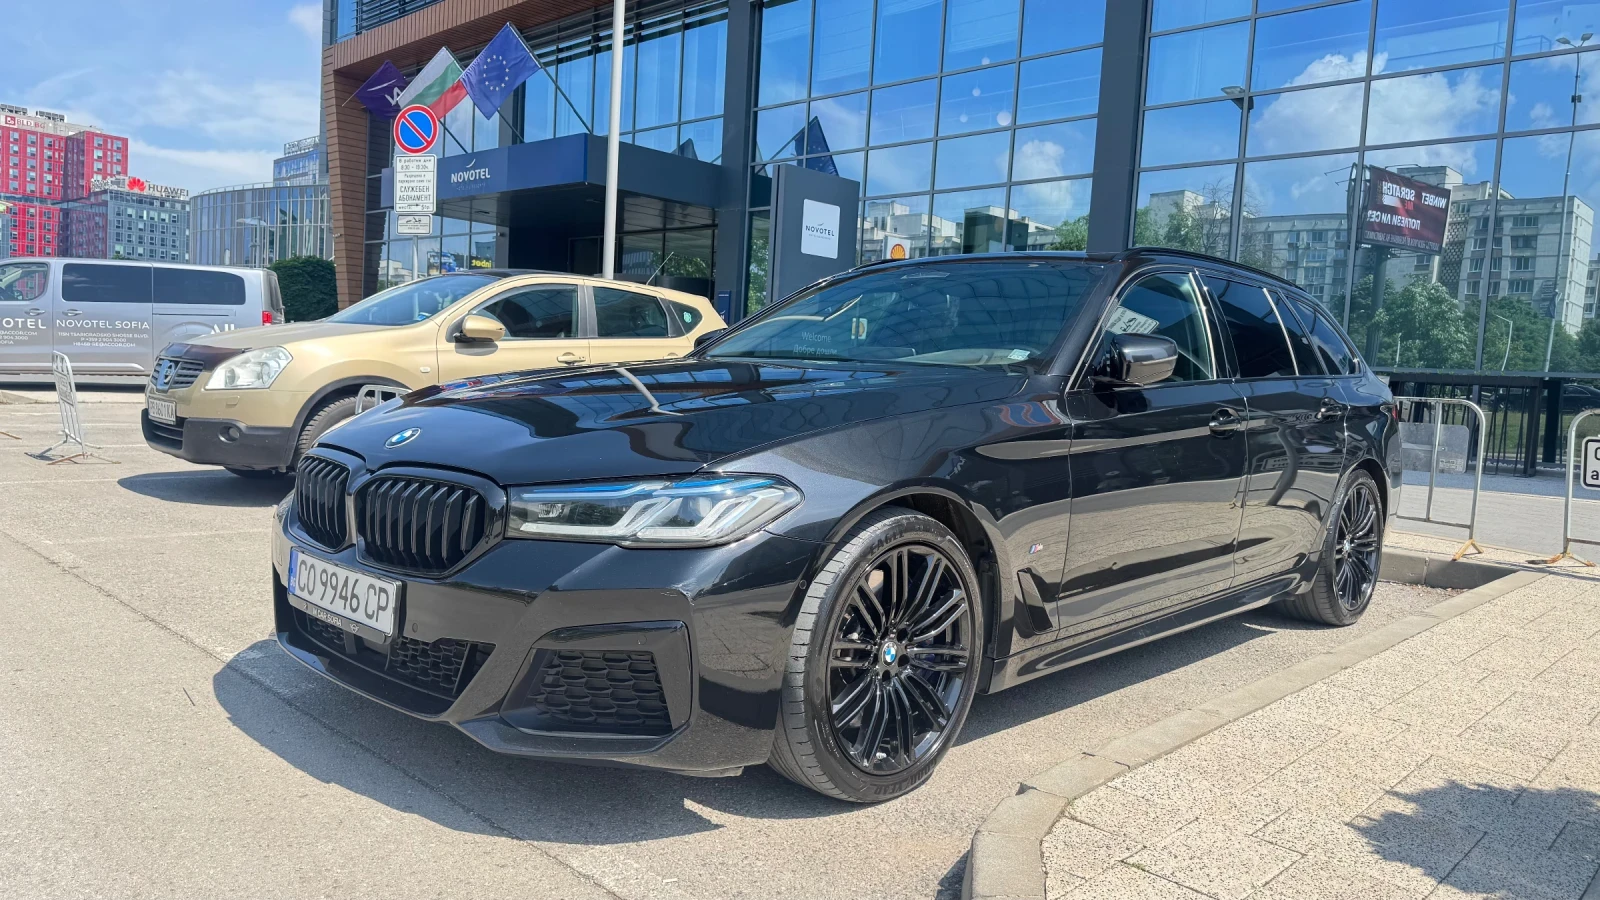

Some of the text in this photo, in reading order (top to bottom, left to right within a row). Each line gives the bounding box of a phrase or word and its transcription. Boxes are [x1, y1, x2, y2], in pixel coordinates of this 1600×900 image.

[450, 168, 491, 183] NOVOTEL
[148, 184, 189, 197] HUAWEI
[399, 185, 430, 193] СЛУЖЕБЕН
[398, 194, 431, 202] АБОНАМЕНТ
[805, 225, 835, 236] NOVOTEL
[0, 317, 47, 329] OTEL
[56, 319, 150, 329] NOVOTEL SOFIA
[801, 331, 832, 343] Welcome
[793, 344, 838, 357] Добре дошли
[319, 568, 360, 613] 9946
[364, 583, 390, 623] CP
[327, 615, 342, 627] SOFIA
